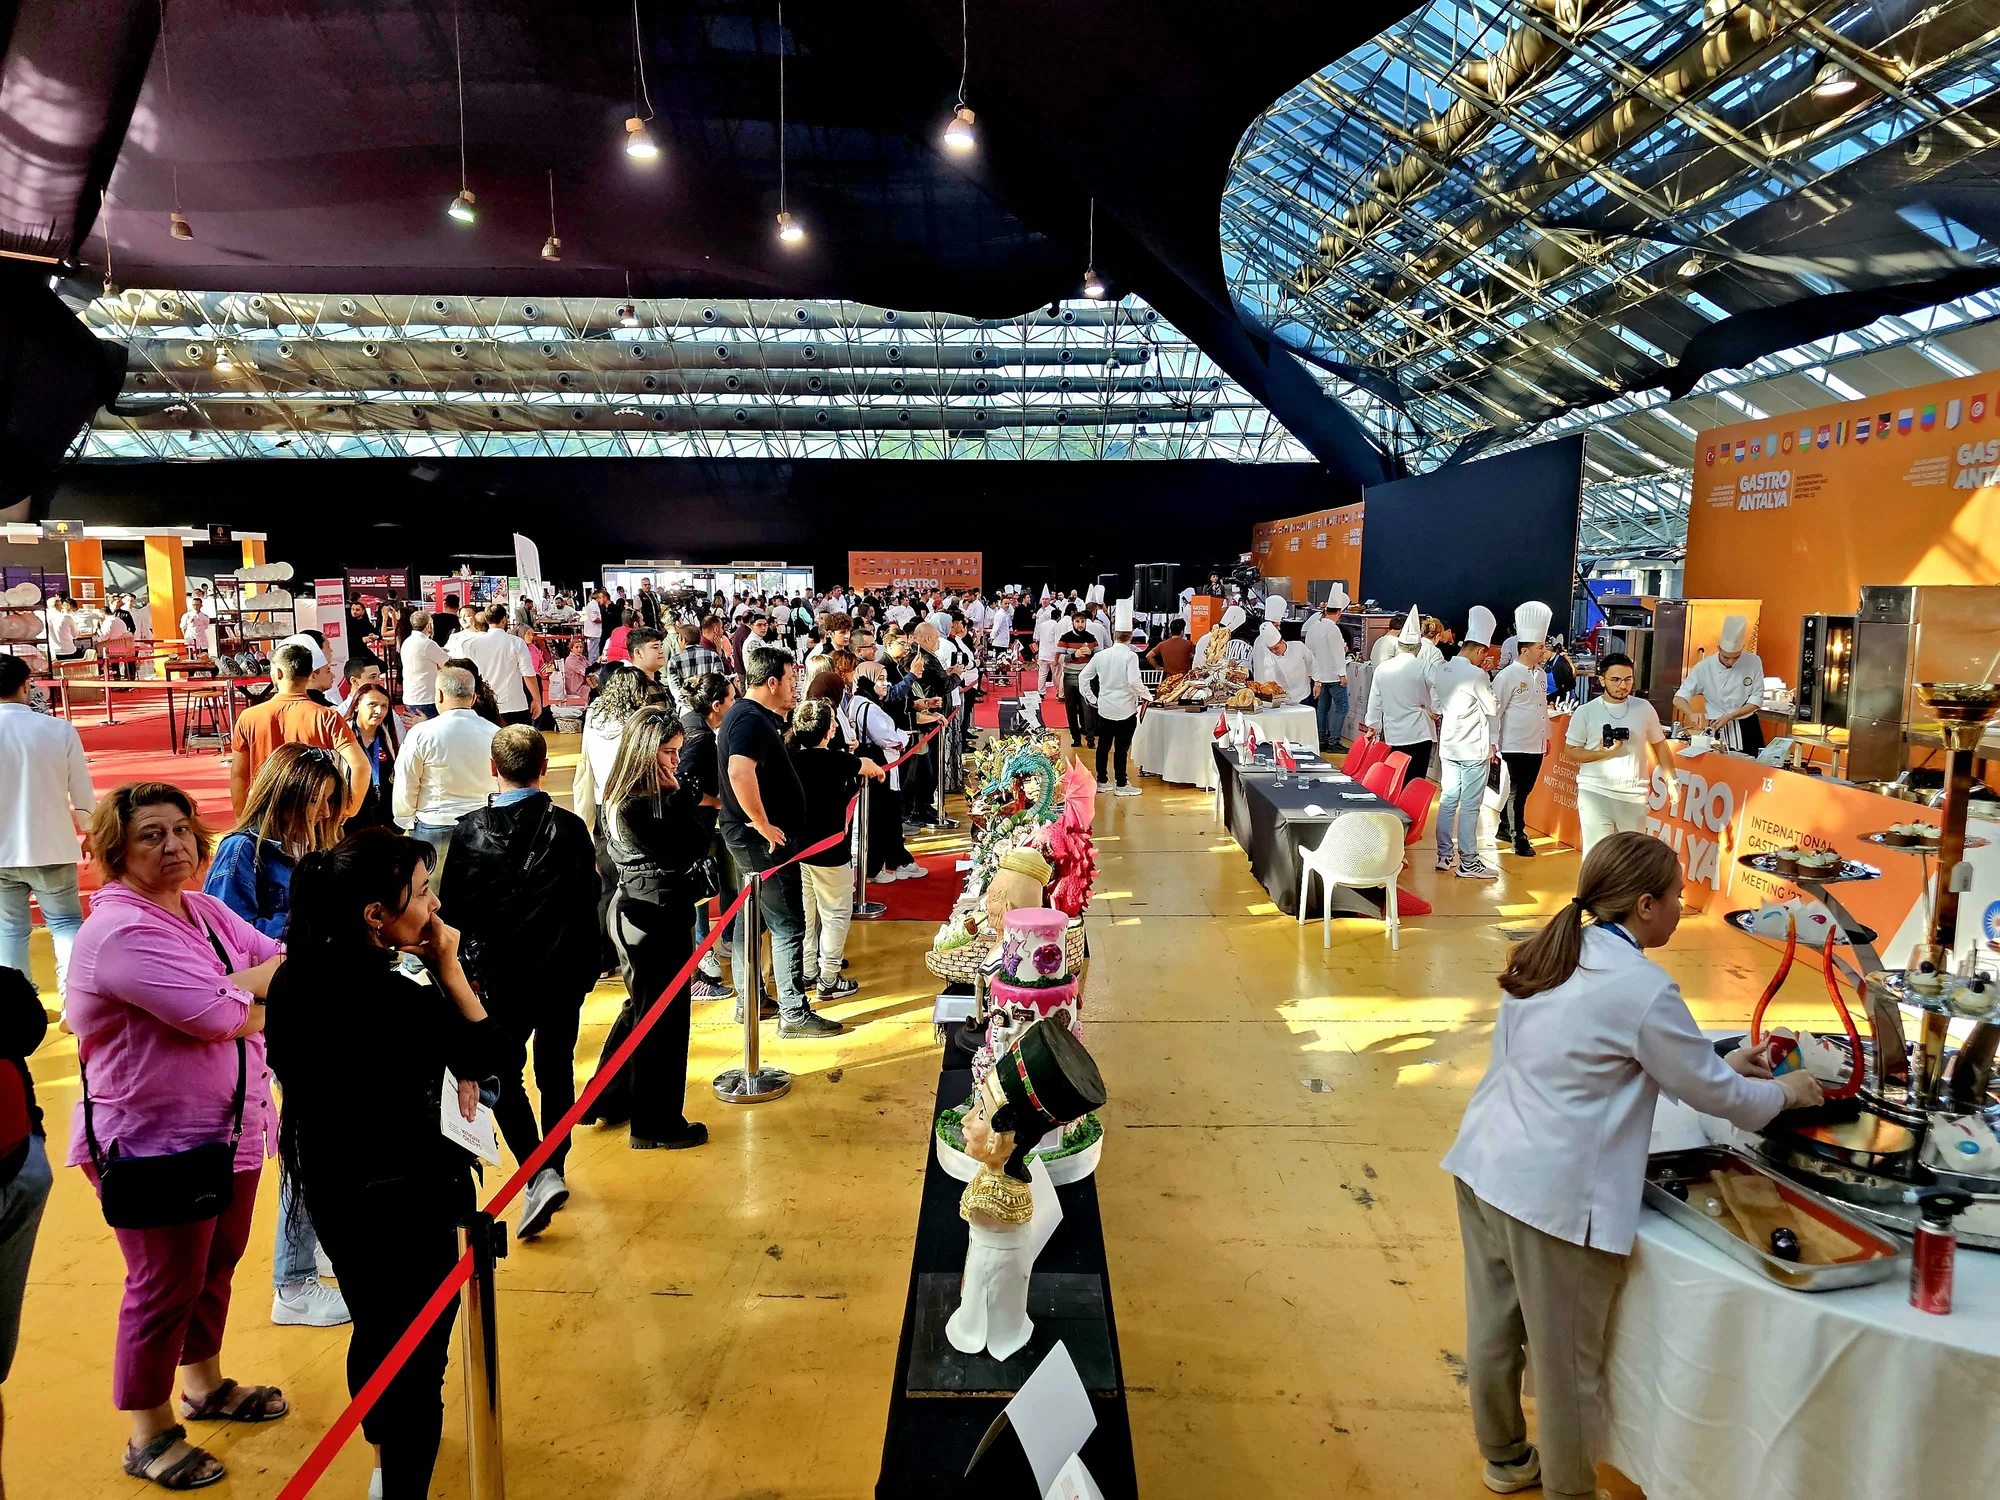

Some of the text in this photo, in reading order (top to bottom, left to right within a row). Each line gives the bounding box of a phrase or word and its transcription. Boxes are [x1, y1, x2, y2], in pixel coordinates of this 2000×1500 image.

[1957, 439, 2000, 466] GAS
[1740, 469, 1791, 493] GASTRO
[1952, 465, 2000, 490] ANTA
[1738, 491, 1788, 511] ANTALYA
[893, 578, 939, 588] GASTRO
[1543, 775, 1578, 796] MUTFAK YILD
[1762, 777, 1773, 793] 13
[1553, 792, 1578, 810] BULUŞM
[1648, 764, 1734, 833] STRO
[1645, 815, 1720, 891] TALYA
[1748, 835, 1780, 854] GASTR
[1741, 871, 1785, 899] MEETING
